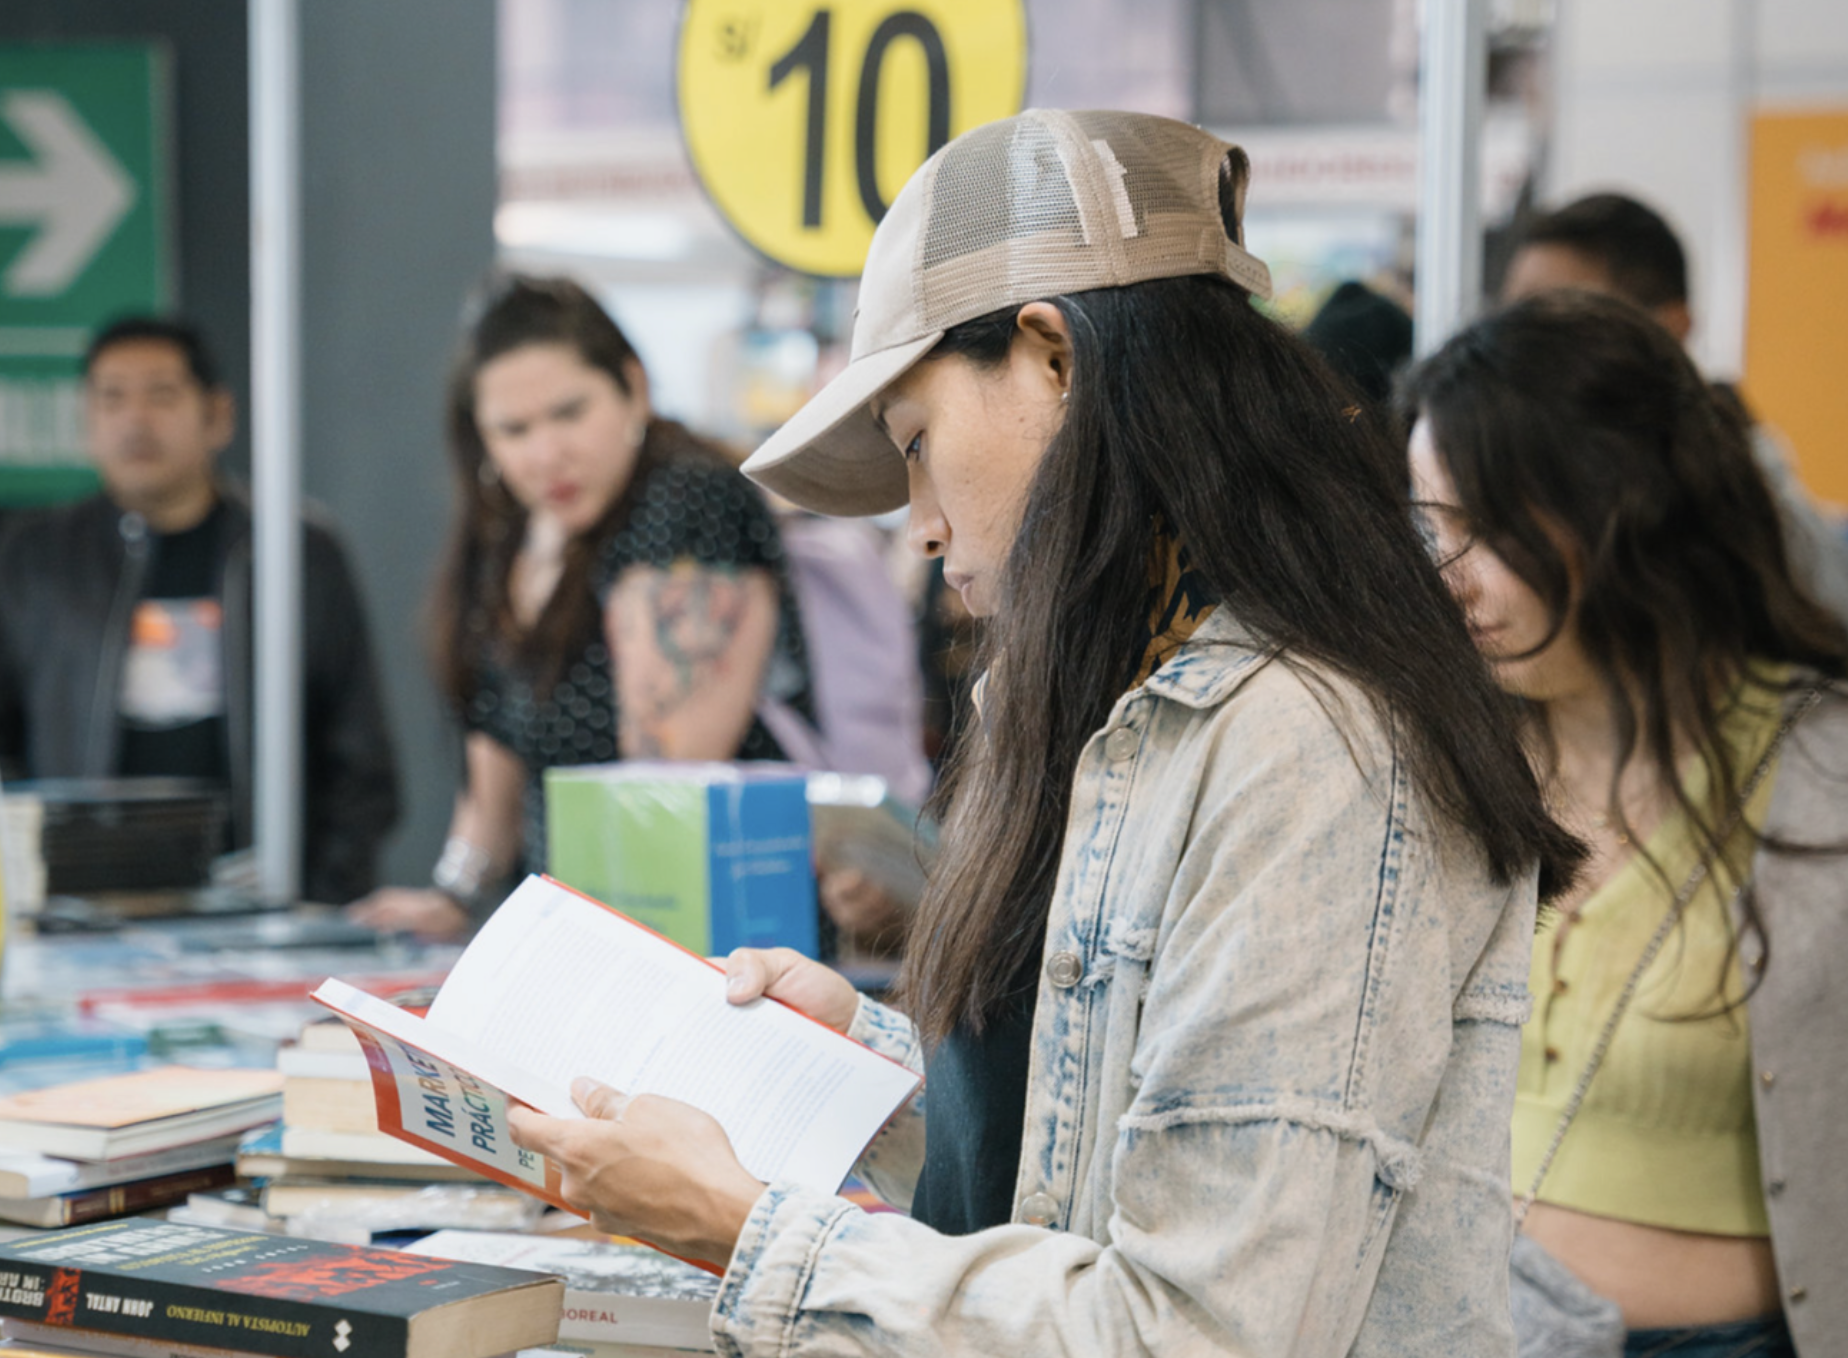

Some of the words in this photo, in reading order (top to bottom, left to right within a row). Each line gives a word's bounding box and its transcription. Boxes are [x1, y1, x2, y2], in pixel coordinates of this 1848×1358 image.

[768, 10, 950, 228] 10
[86, 1292, 122, 1313] ANTAL
[122, 1299, 153, 1318] JOHN
[166, 1304, 225, 1325] INFIERNO
[226, 1313, 242, 1327] AL
[243, 1315, 310, 1337] AUTOPISTA
